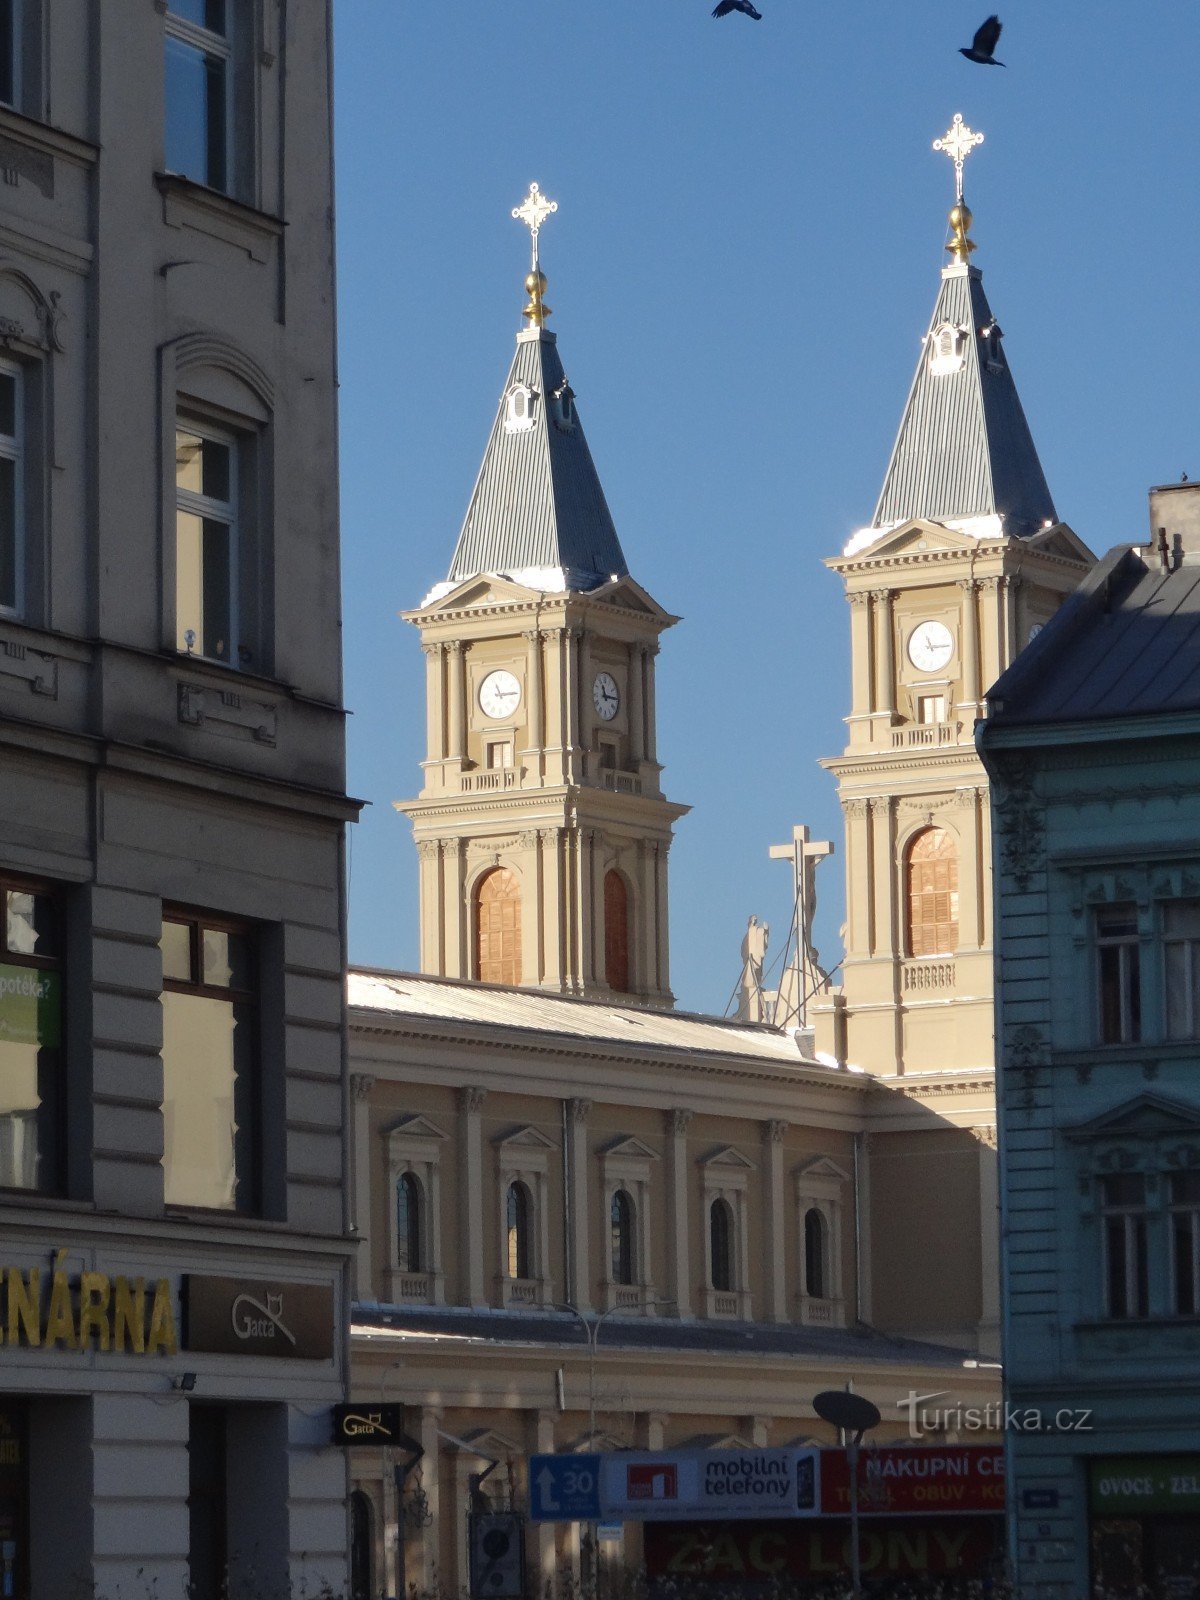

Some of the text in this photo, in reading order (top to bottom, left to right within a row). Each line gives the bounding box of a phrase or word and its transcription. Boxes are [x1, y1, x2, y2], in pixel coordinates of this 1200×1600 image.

[0, 1248, 177, 1355] NÁRNA
[232, 1293, 296, 1345] Gatta
[343, 1414, 391, 1435] Gatta
[706, 1455, 788, 1476] mobilní
[867, 1453, 969, 1477] NÁKUPNÍ
[562, 1470, 593, 1494] 30
[705, 1476, 791, 1498] telefony
[913, 1484, 965, 1501] OBUV
[1100, 1477, 1154, 1495] OVOCE
